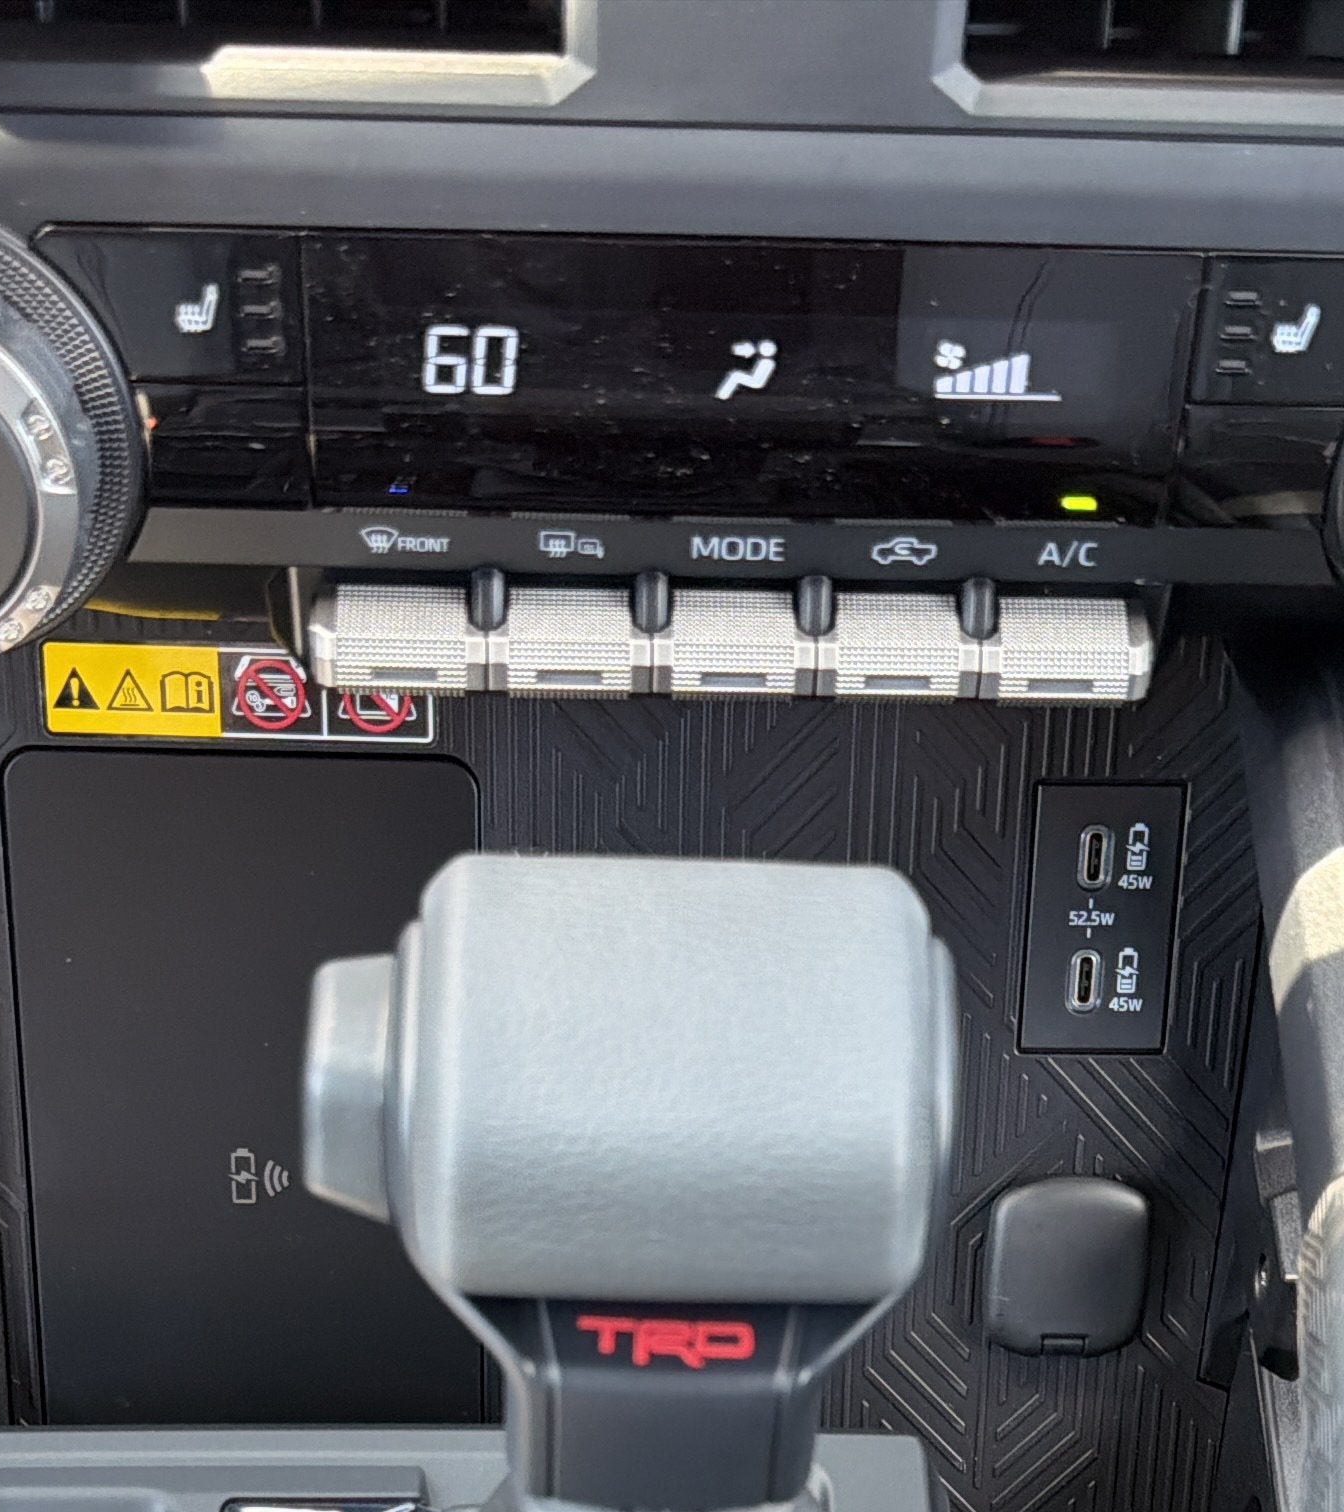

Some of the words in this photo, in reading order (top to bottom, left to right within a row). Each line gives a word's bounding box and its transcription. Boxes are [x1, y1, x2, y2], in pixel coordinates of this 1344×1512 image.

[422, 325, 518, 396] 60
[397, 536, 450, 553] FRONT
[691, 535, 786, 562] MODE
[1039, 541, 1098, 569] A/C
[1117, 874, 1154, 890] 45W
[1068, 910, 1115, 926] 52.5W
[1108, 997, 1143, 1012] 45W
[575, 1314, 755, 1369] TRD
